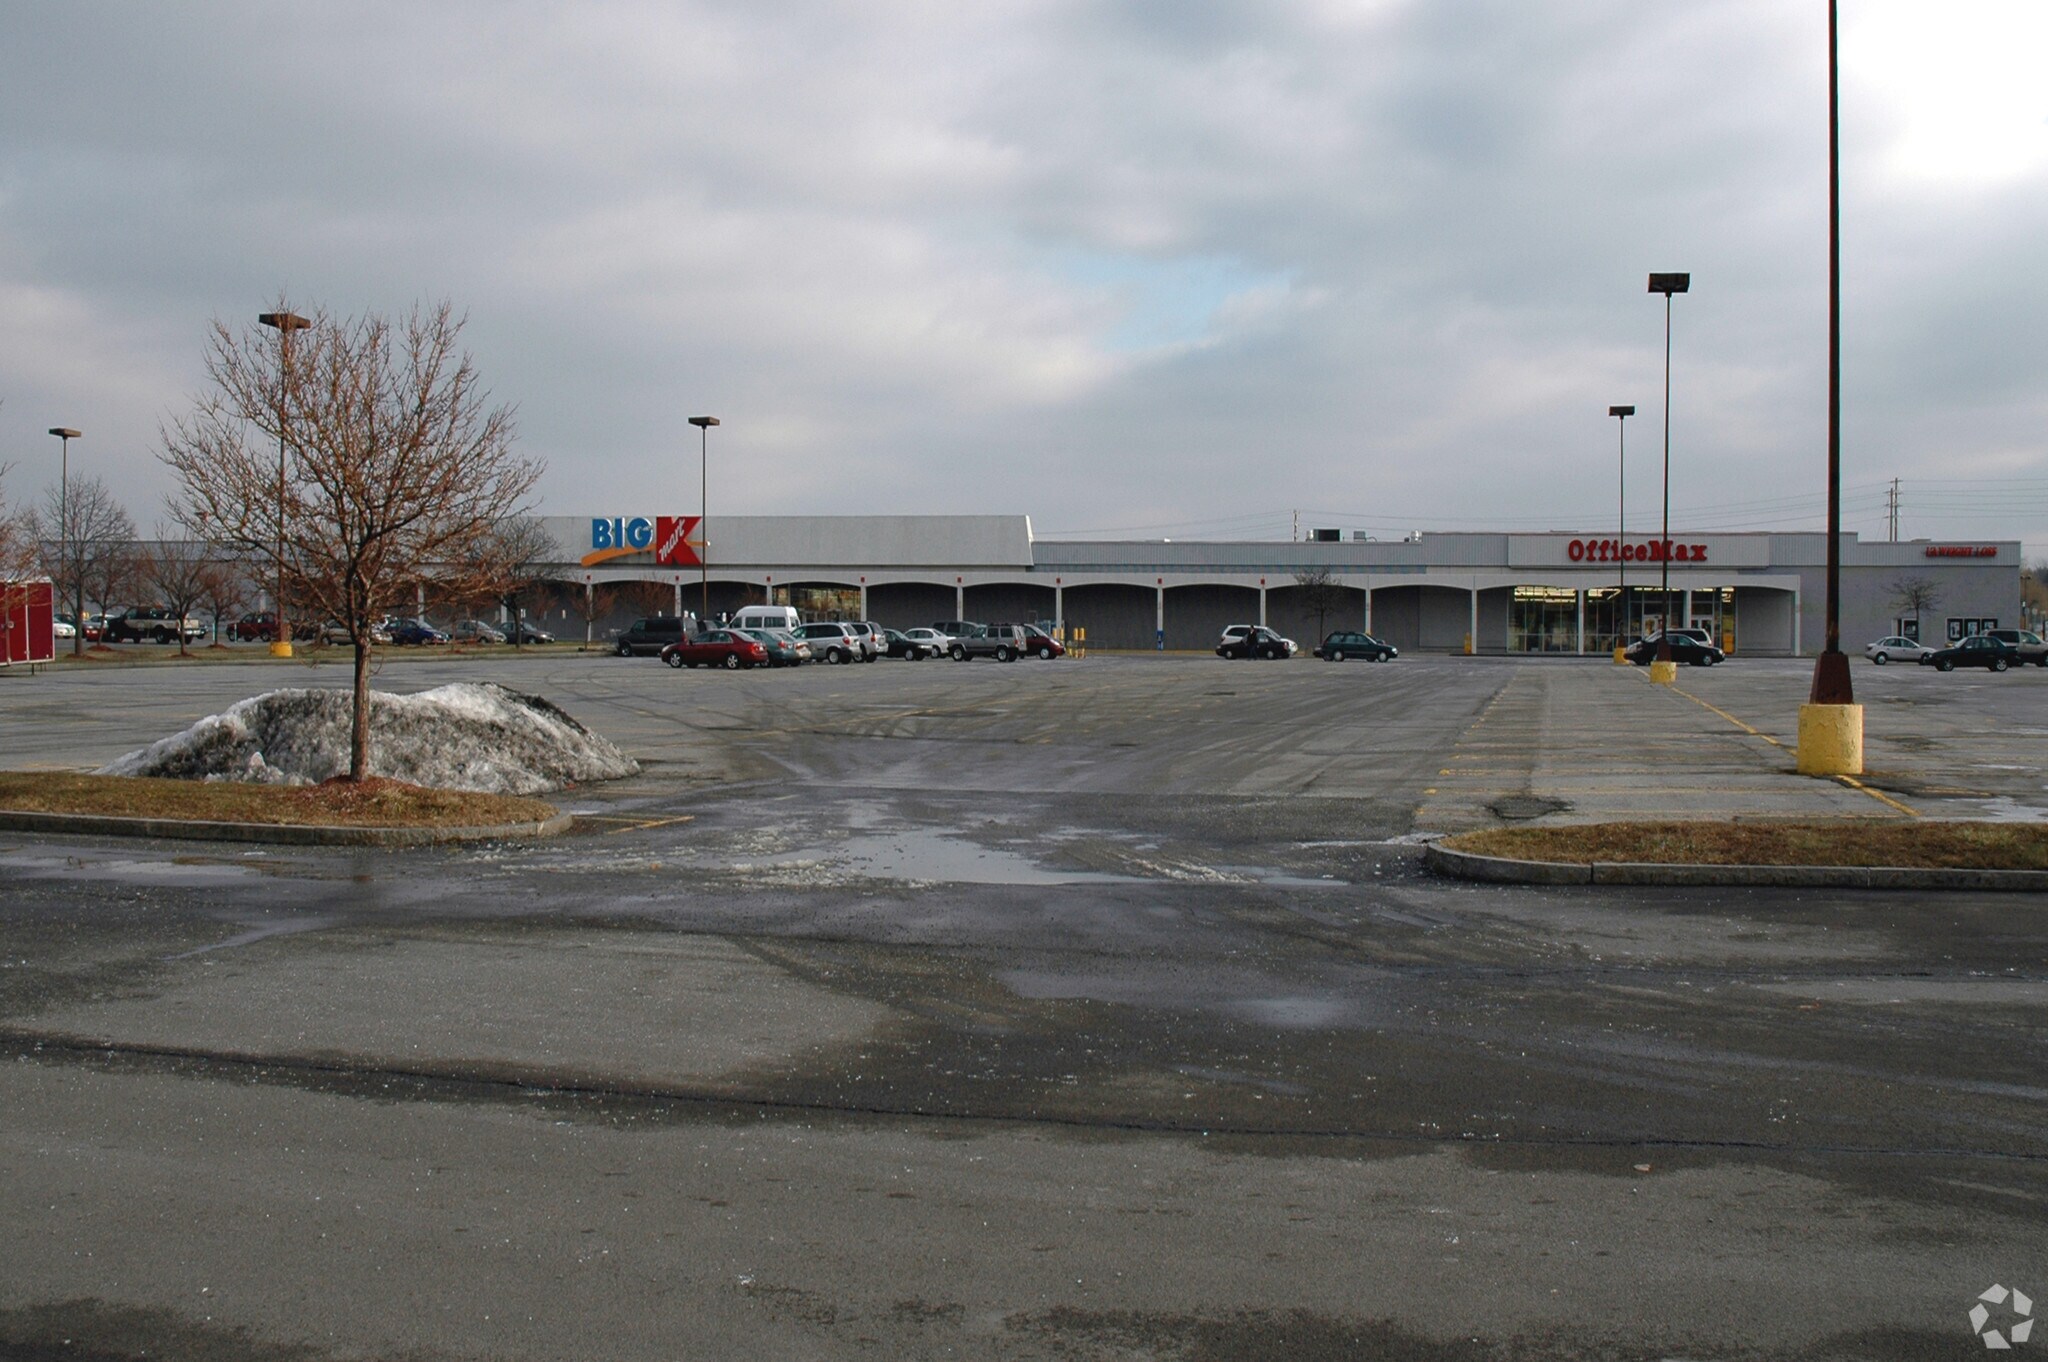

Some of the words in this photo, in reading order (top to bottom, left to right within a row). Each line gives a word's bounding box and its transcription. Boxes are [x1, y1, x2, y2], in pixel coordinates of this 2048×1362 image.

[592, 517, 653, 549] BIG
[659, 518, 685, 562] mart
[1568, 539, 1708, 561] OfficeMax
